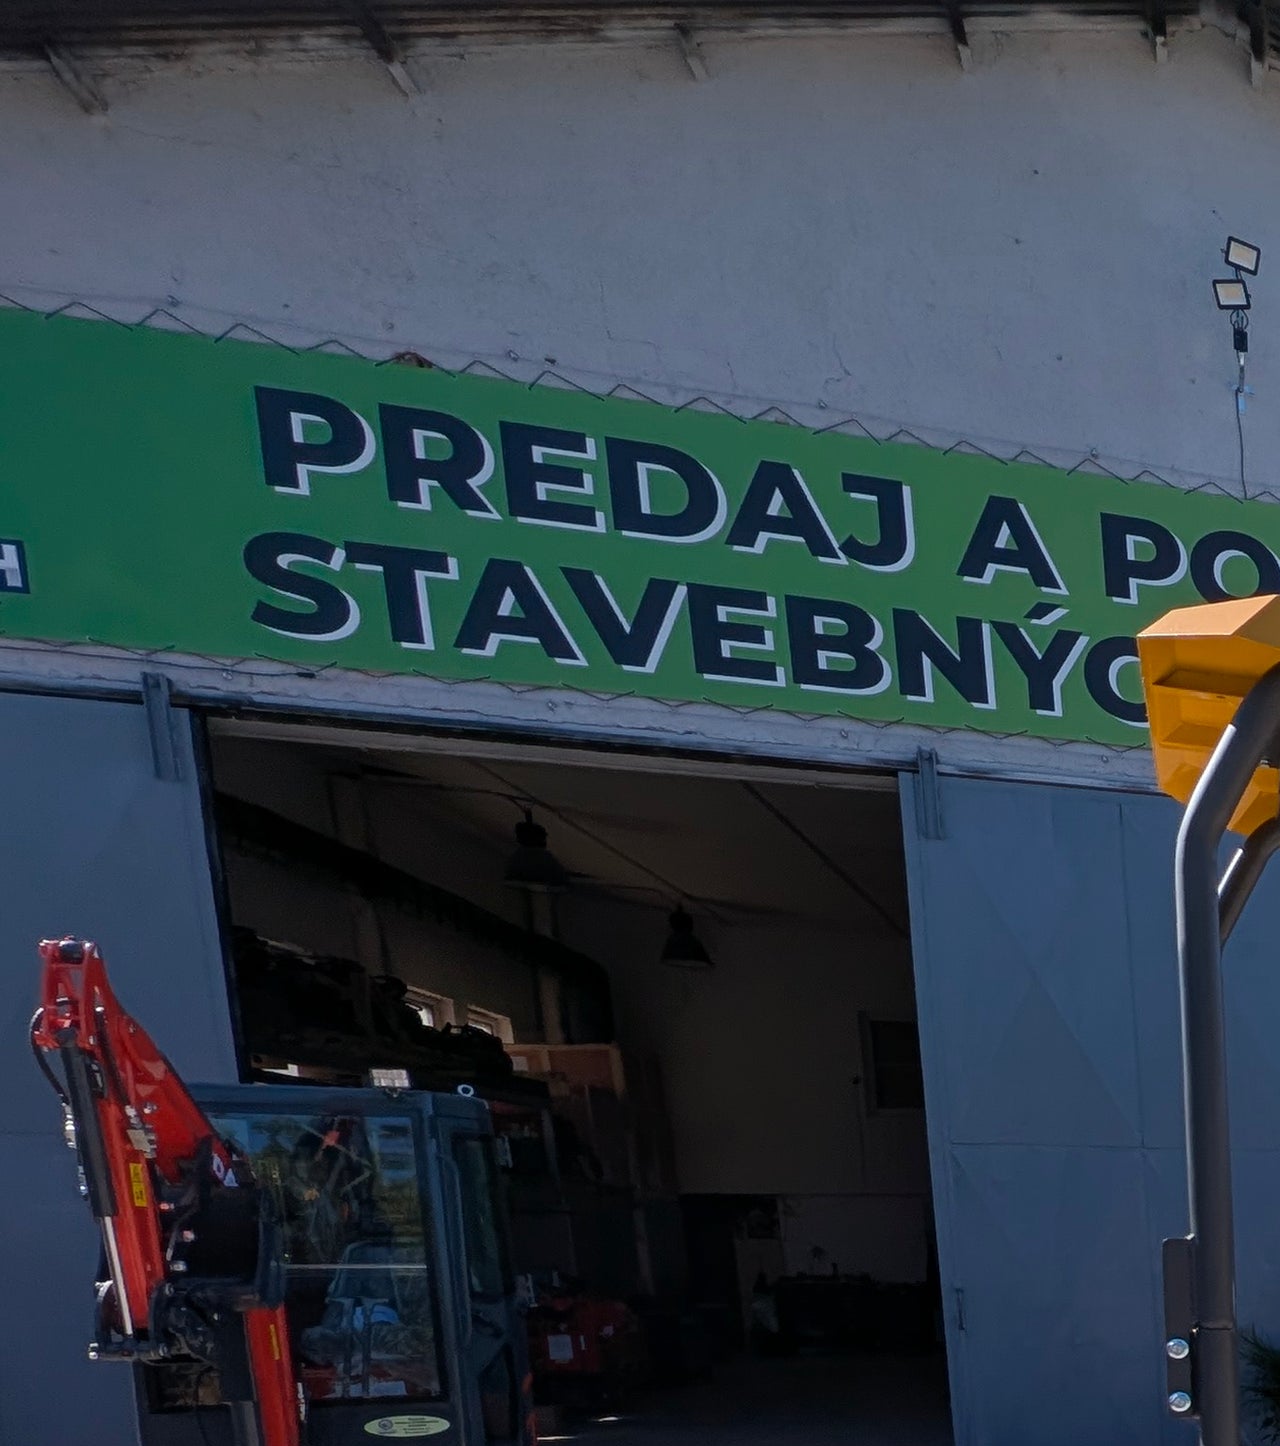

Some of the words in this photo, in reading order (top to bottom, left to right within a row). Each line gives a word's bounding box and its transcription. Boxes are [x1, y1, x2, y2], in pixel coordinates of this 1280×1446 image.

[254, 385, 914, 572] PREDAJ
[956, 495, 1069, 595] A
[243, 532, 1150, 728] STAVEBNÝC
